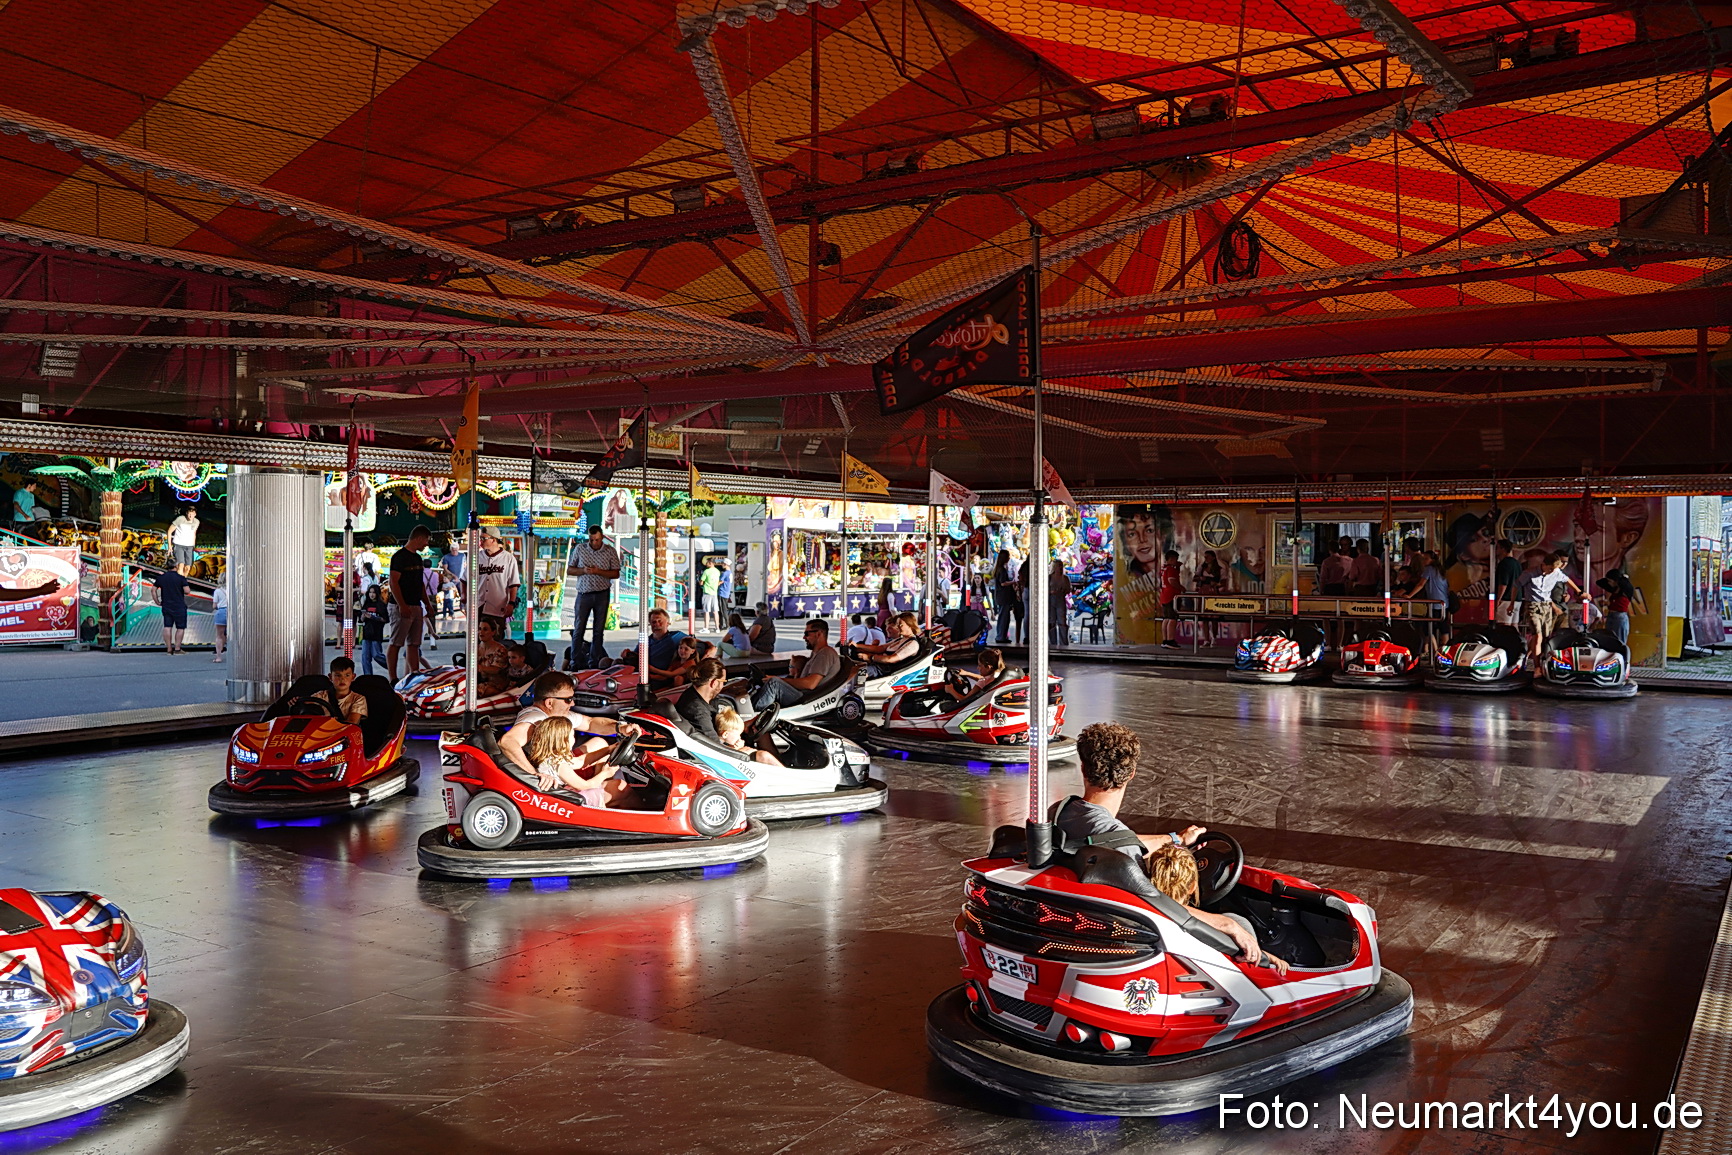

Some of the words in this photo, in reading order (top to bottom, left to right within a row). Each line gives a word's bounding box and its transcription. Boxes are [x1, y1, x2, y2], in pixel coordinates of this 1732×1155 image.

[1357, 605, 1375, 613] rechts
[812, 695, 837, 712] Hello
[330, 754, 346, 765] FIRE
[442, 754, 461, 766] 22
[737, 762, 756, 780] NYPD
[529, 794, 574, 819] Nader
[997, 956, 1021, 978] 22
